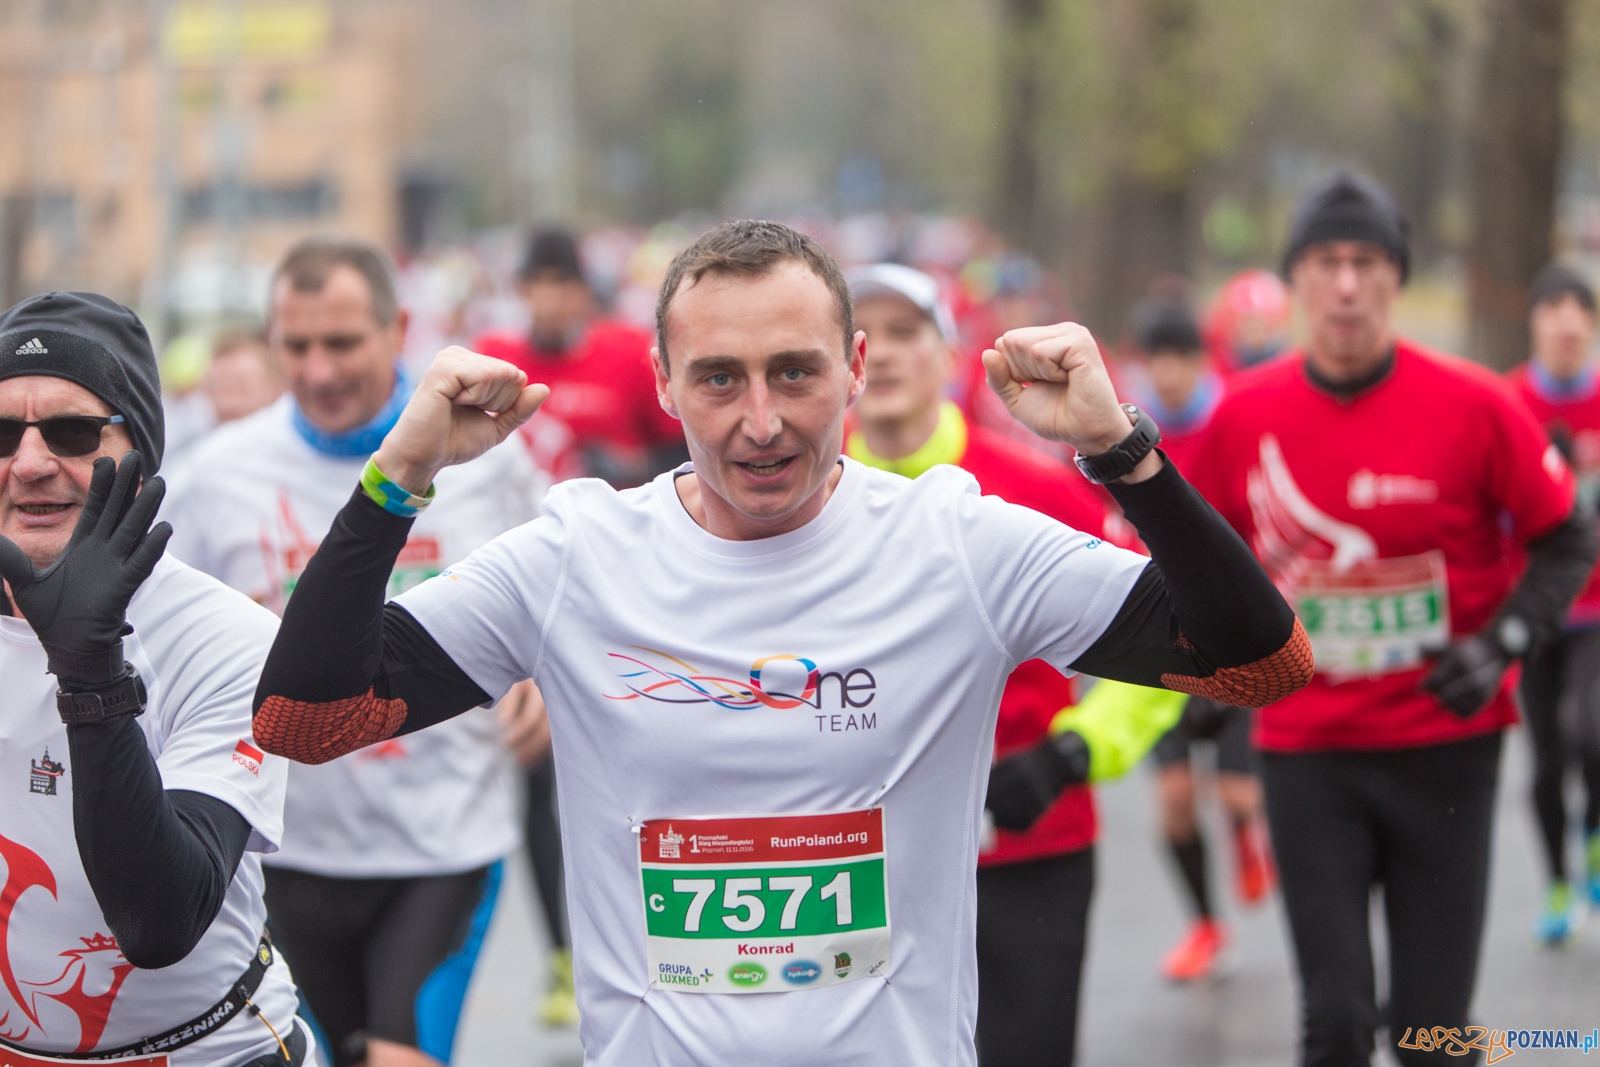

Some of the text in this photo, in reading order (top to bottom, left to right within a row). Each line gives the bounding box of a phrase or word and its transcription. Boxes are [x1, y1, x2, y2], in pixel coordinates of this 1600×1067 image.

[15, 347, 49, 355] adidas
[749, 654, 877, 709] One
[815, 712, 877, 732] TEAM
[232, 753, 259, 777] POLSKA
[689, 834, 700, 853] 1
[770, 831, 868, 848] RunPoland.org
[672, 870, 853, 933] 7571
[737, 943, 795, 955] Konrad
[659, 963, 692, 975] GRUPA
[660, 973, 700, 986] LUXMED
